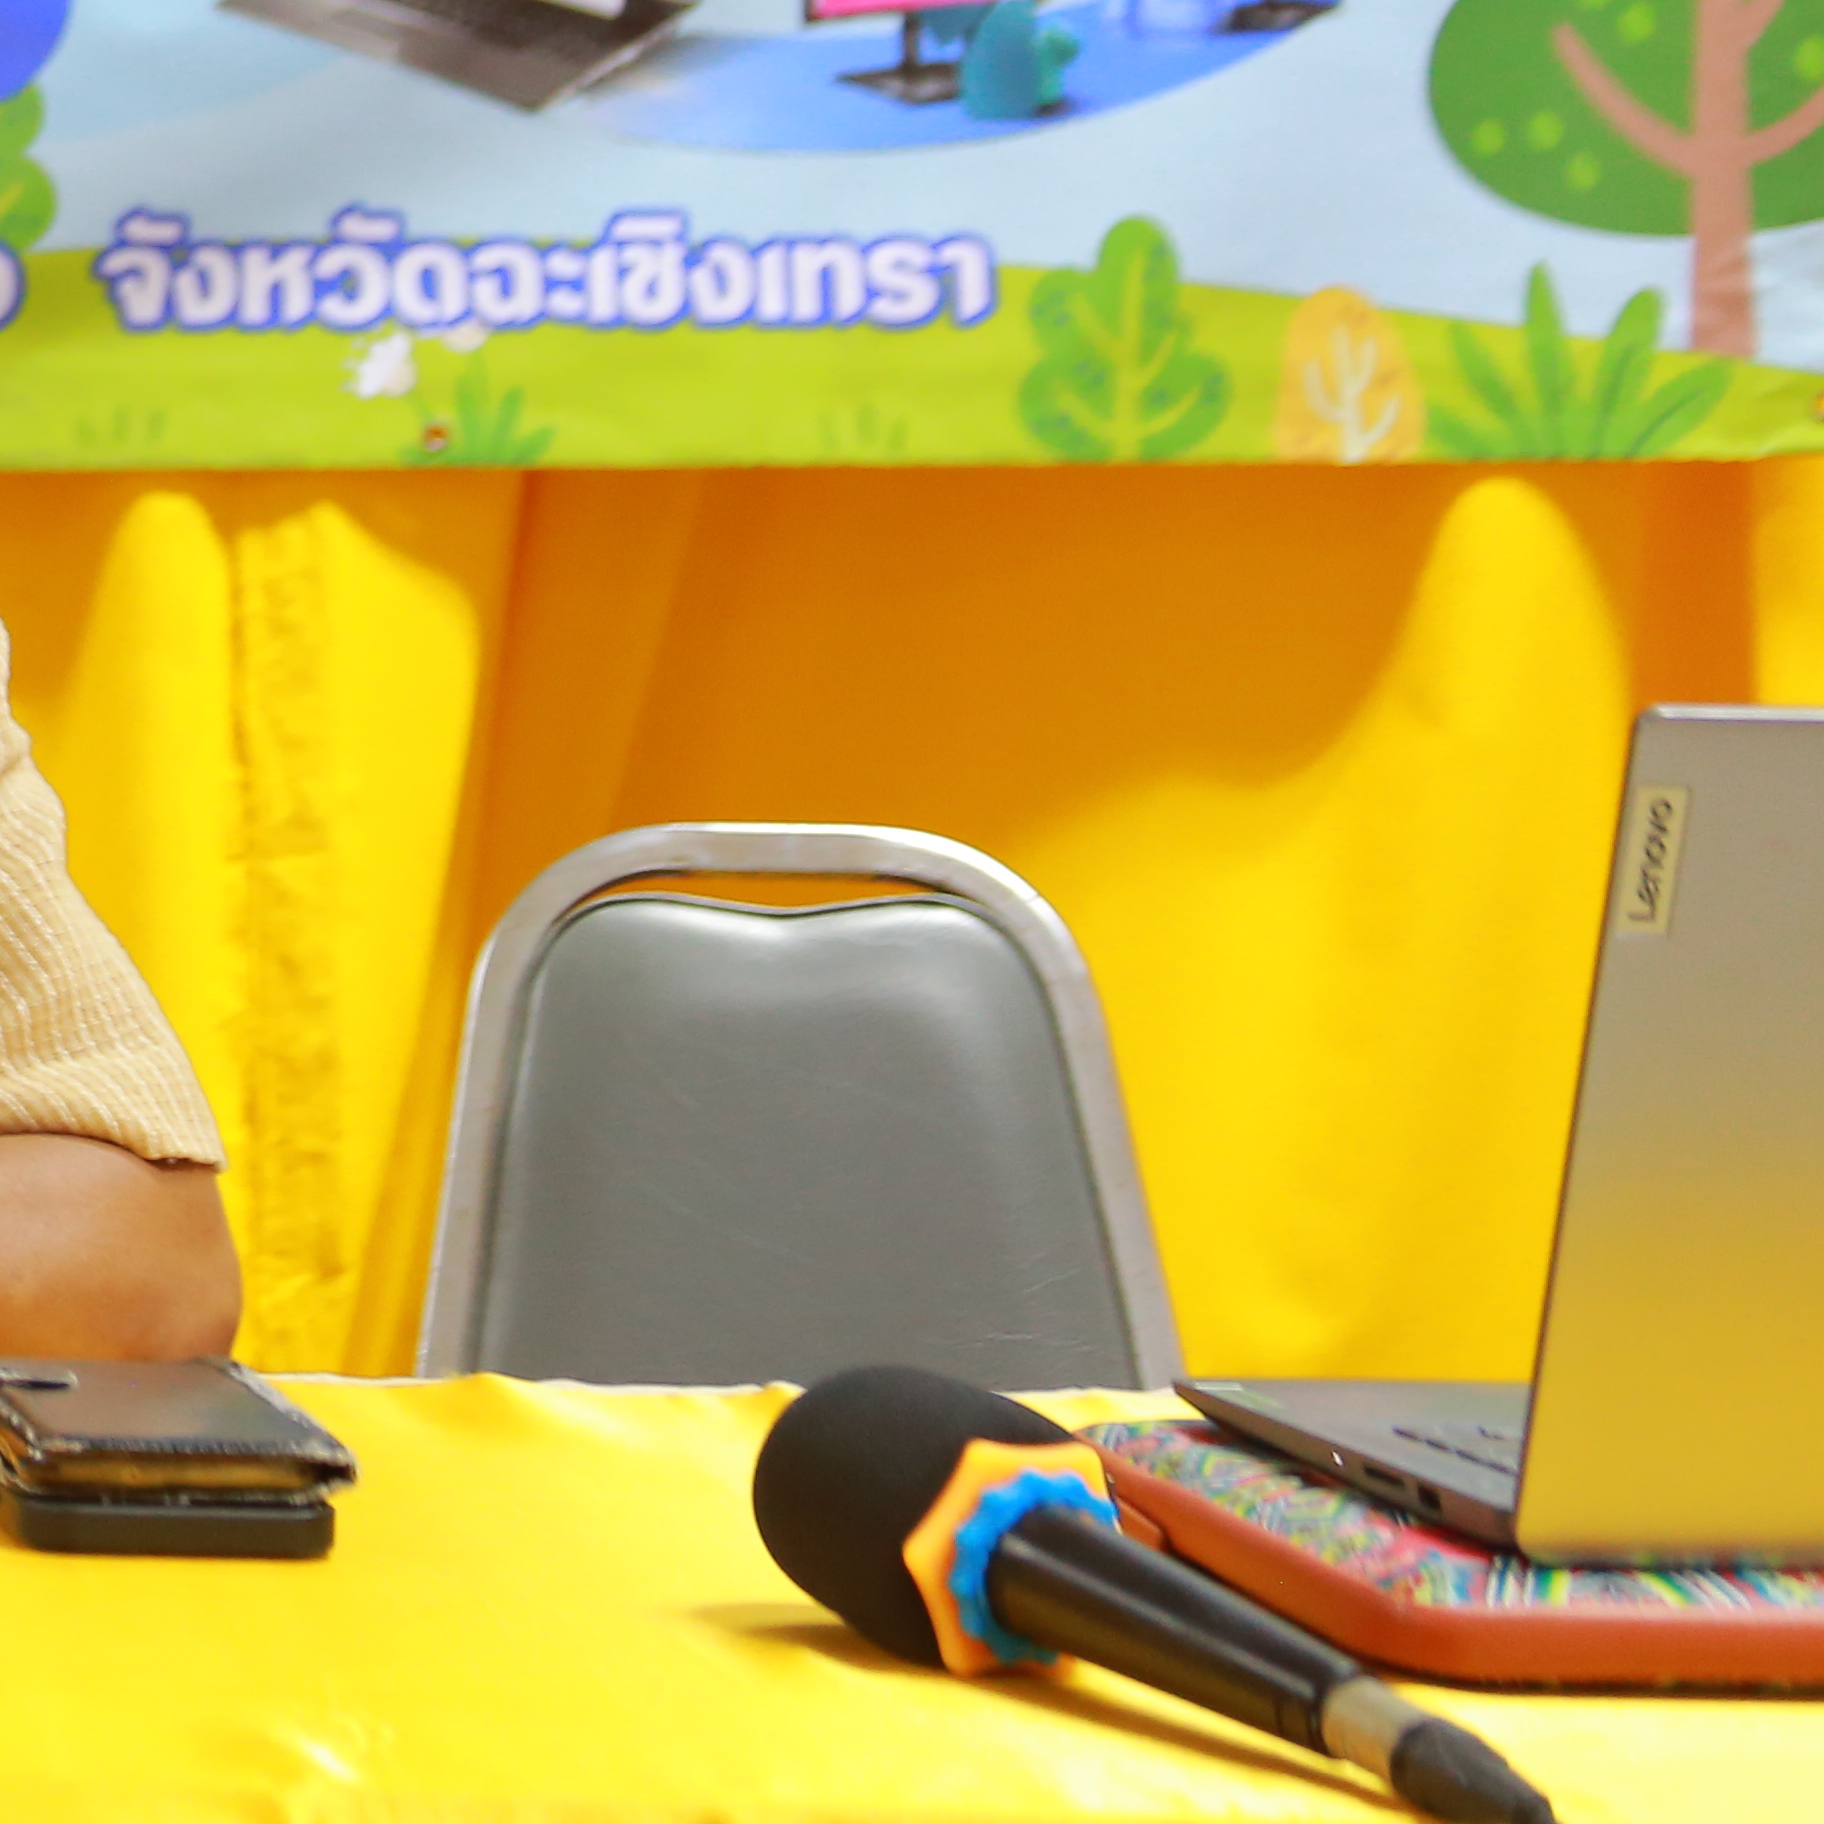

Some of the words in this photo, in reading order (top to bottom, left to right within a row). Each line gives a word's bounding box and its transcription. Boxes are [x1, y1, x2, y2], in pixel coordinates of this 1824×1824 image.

[94, 208, 996, 331] จังหวัดฉะเชิงเทรา
